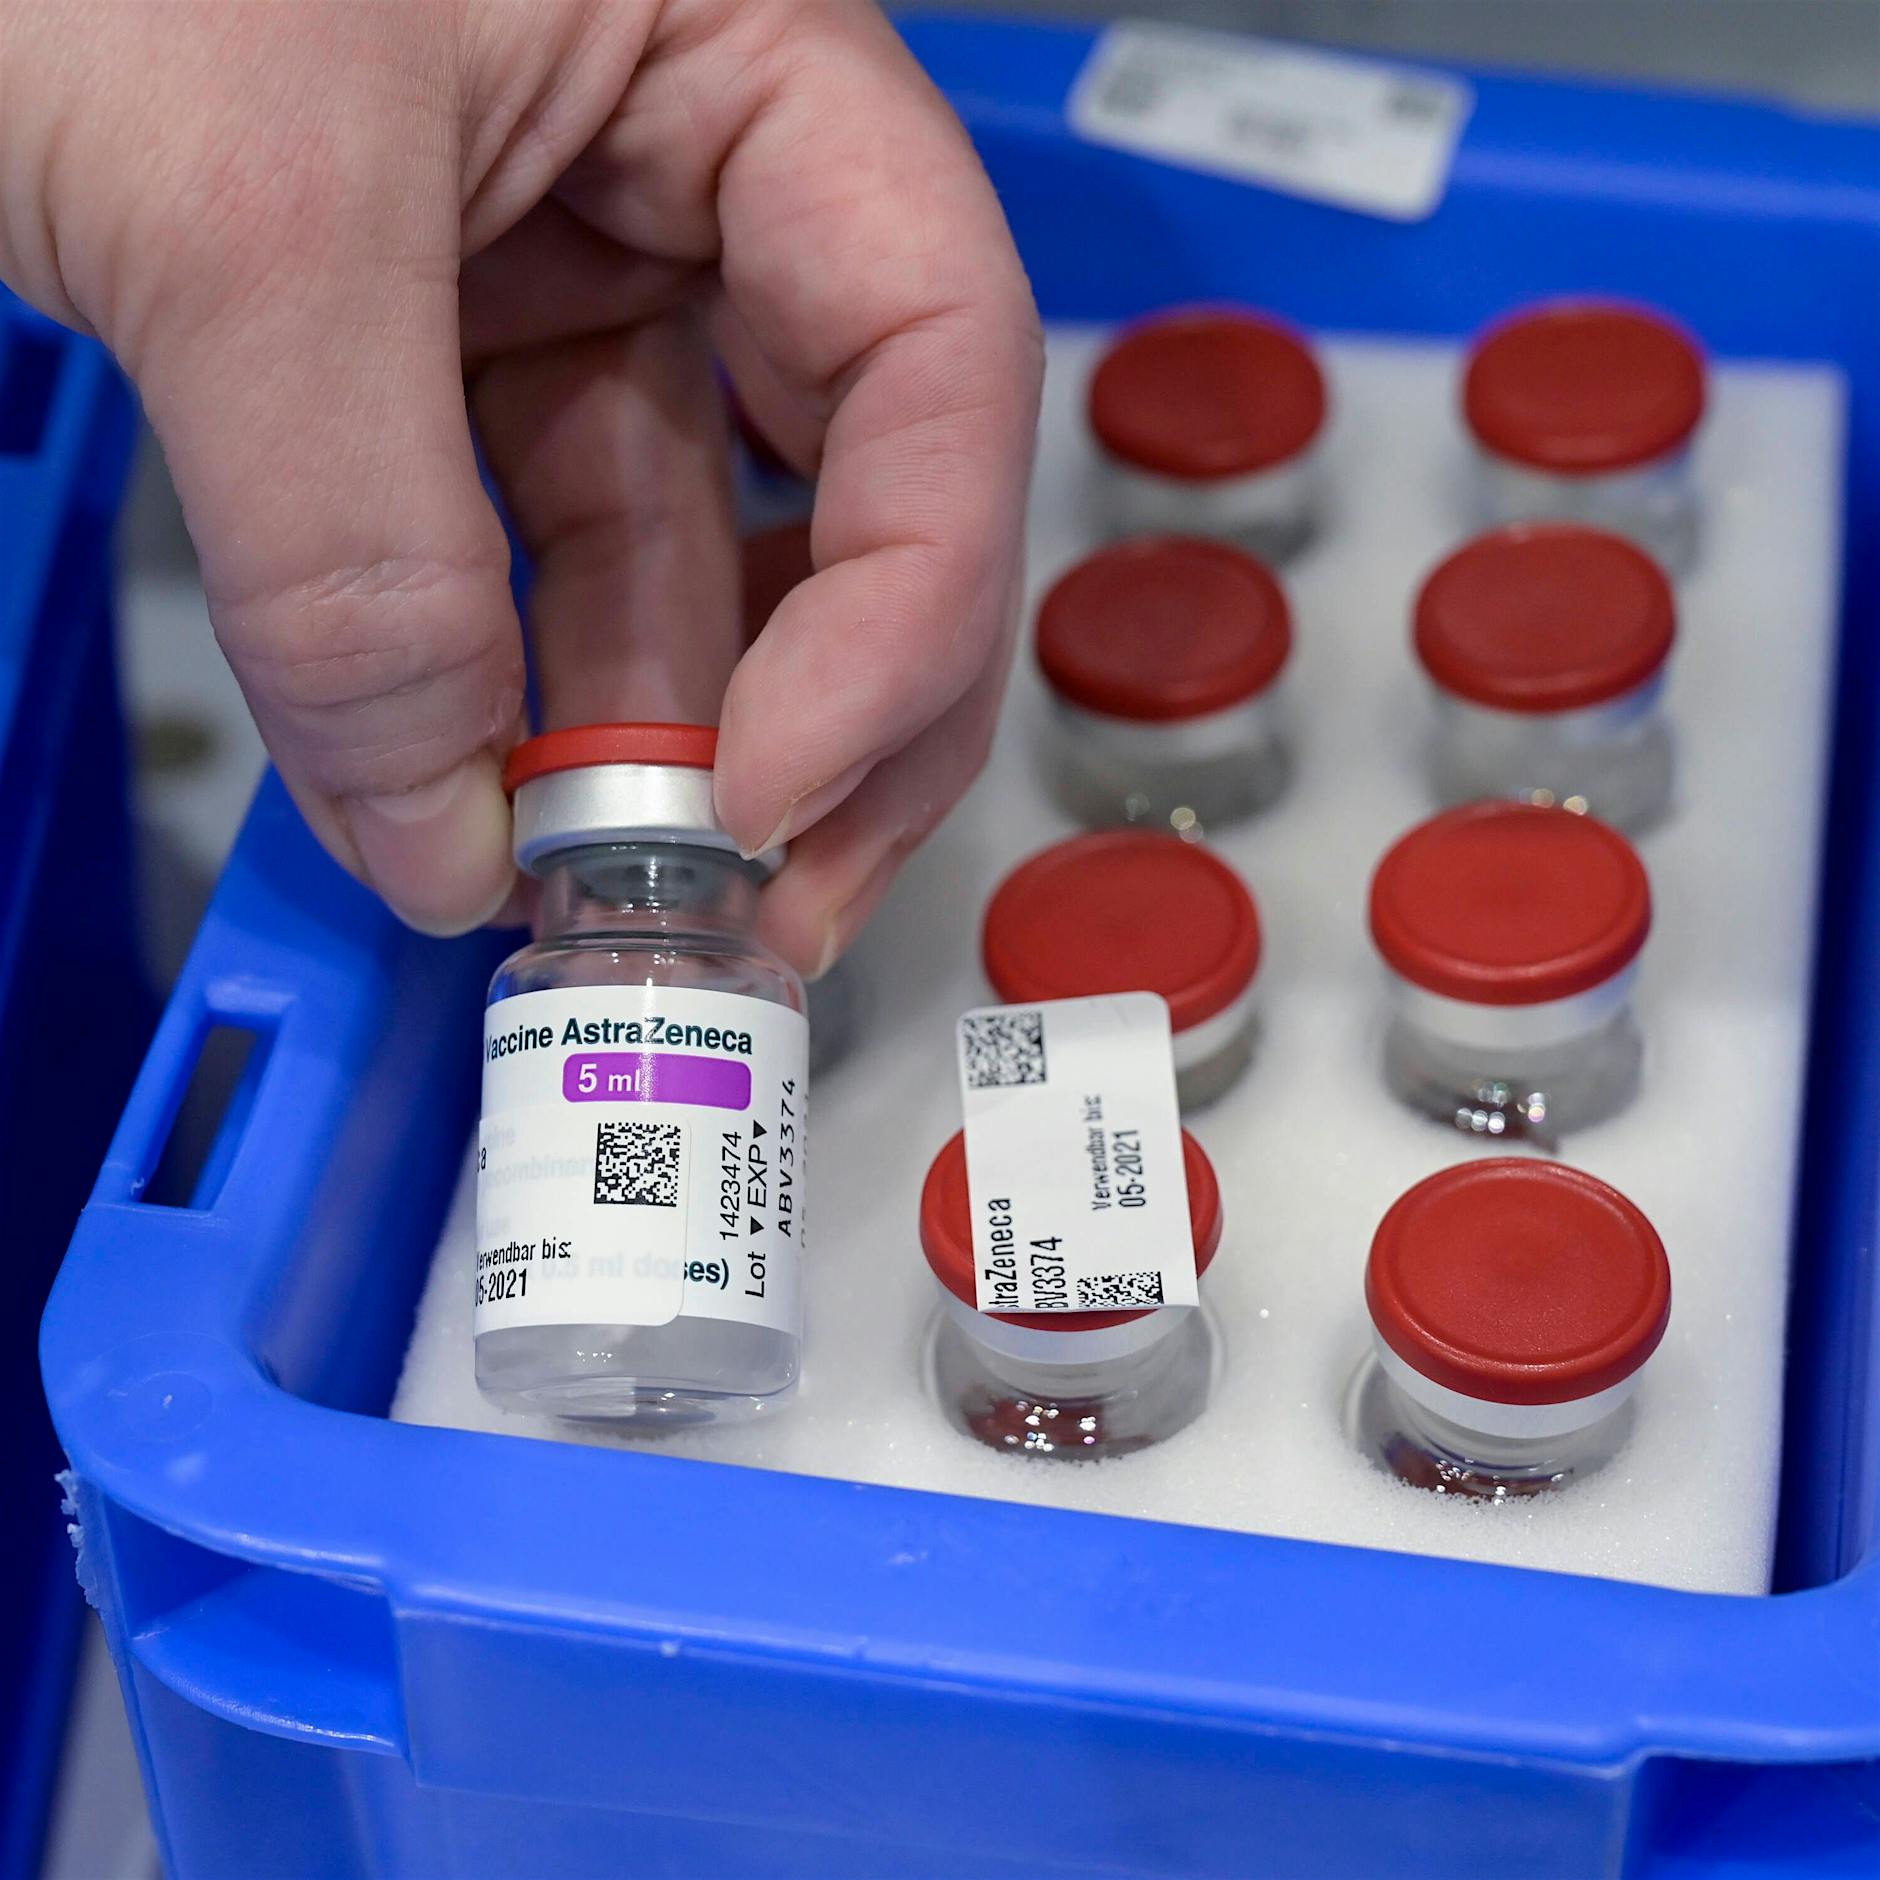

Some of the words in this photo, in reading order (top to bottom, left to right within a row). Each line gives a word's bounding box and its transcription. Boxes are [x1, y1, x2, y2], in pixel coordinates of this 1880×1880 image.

[486, 1025, 553, 1062] Vaccine
[561, 1016, 753, 1055] AstraZeneca
[578, 1063, 598, 1093] 5
[608, 1070, 642, 1092] ml
[720, 1131, 742, 1241] 1423474
[748, 1143, 768, 1209] EXP
[778, 1078, 797, 1238] ABV3374
[1086, 1127, 1112, 1212] Verwendbar
[745, 1250, 767, 1299] Lot
[985, 1197, 1020, 1308] traZeneca
